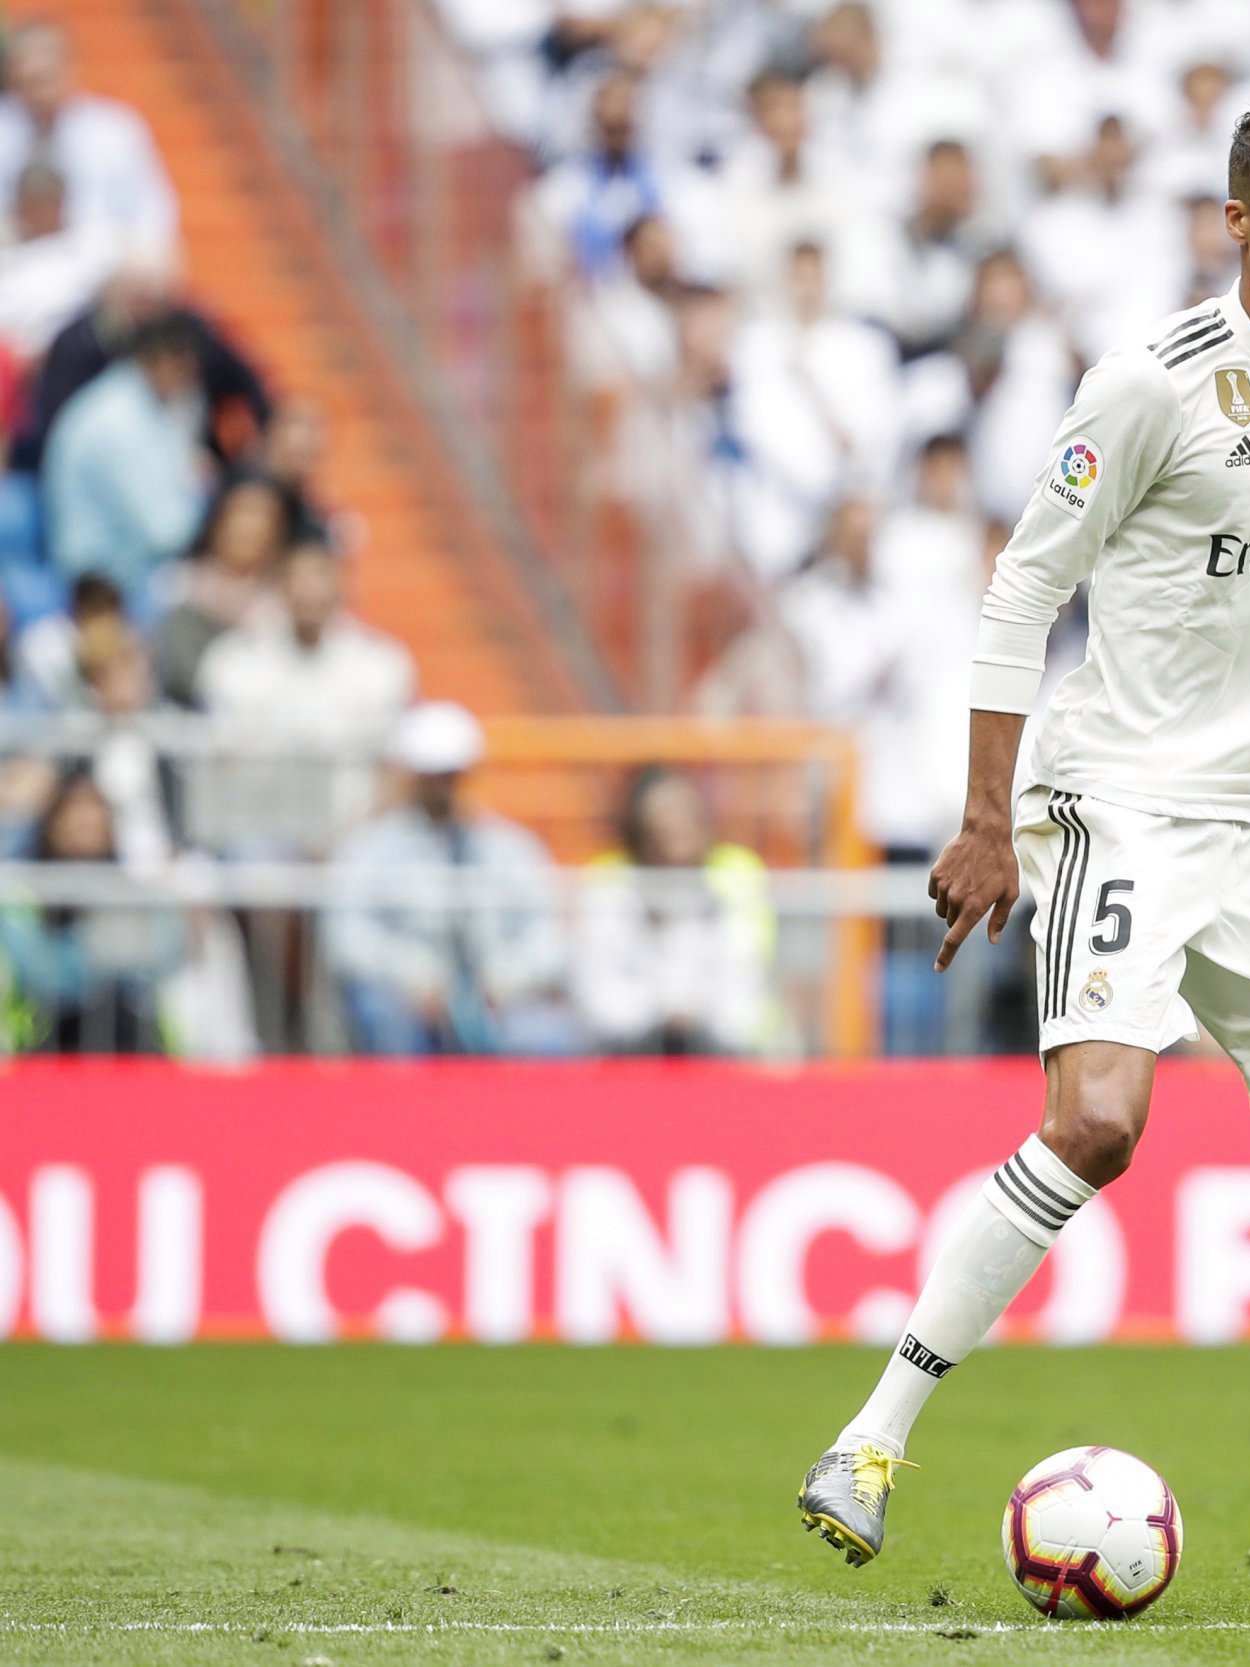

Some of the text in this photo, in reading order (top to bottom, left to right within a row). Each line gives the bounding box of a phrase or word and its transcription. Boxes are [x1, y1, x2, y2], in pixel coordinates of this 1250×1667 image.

[1231, 405, 1249, 413] FIFA
[1049, 478, 1085, 508] LaLiga
[1089, 879, 1135, 956] 5
[0, 1162, 203, 1346] U
[256, 1160, 1127, 1346] CINCO
[901, 1335, 956, 1377] RMC
